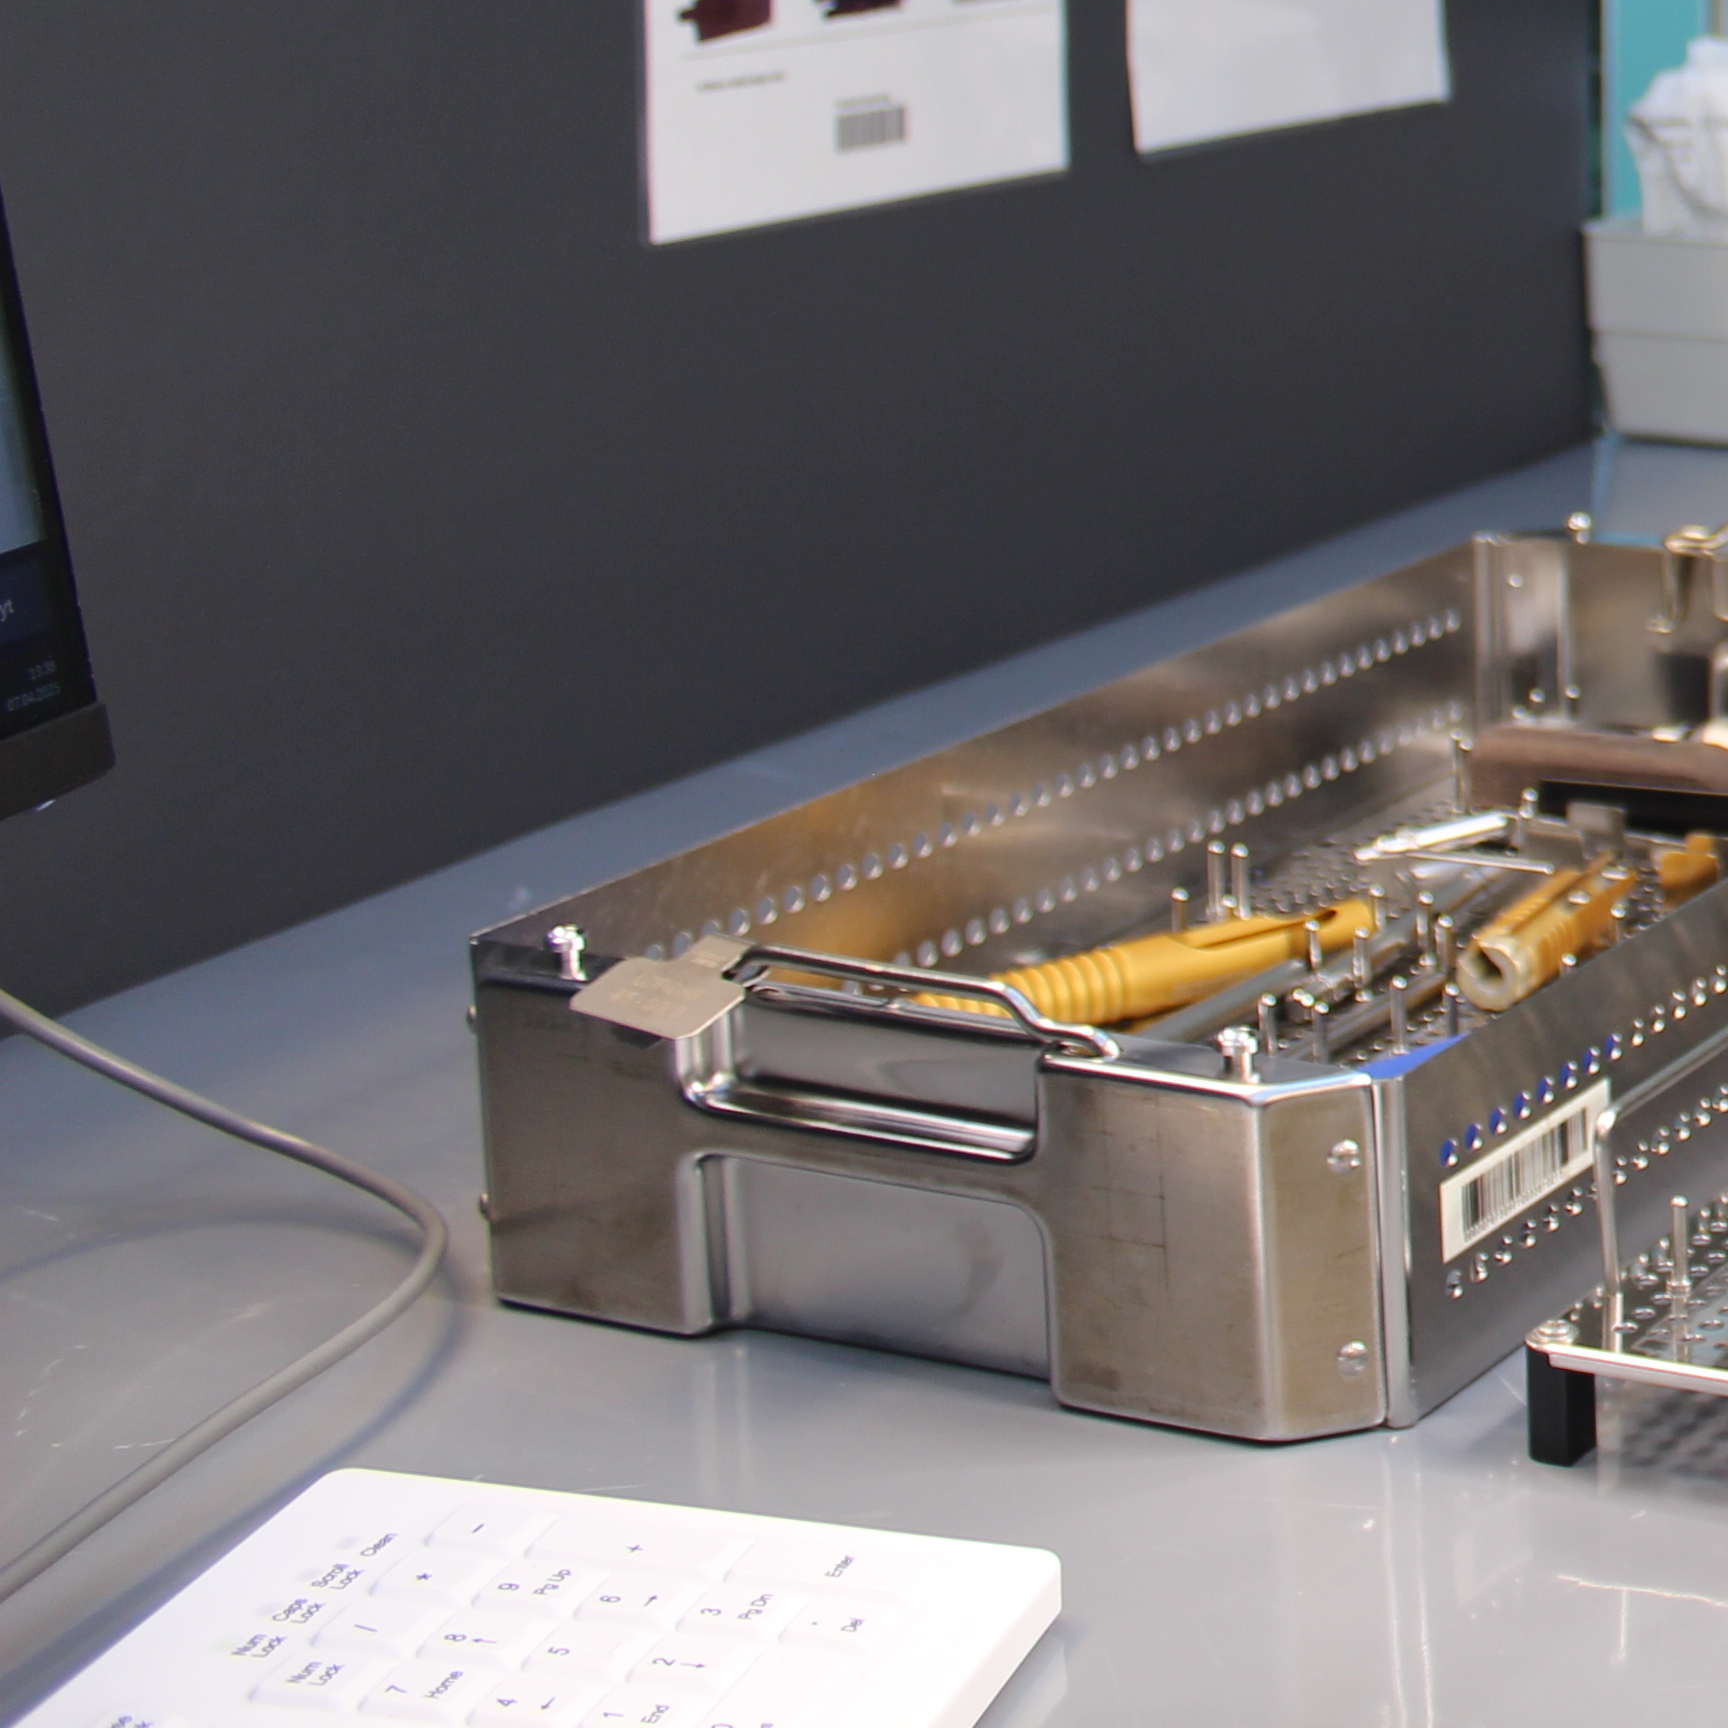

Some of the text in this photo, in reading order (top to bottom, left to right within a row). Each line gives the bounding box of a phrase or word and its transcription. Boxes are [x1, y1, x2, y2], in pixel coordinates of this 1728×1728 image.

[360, 1533, 397, 1556] Clean
[311, 1563, 349, 1588] Scroll
[826, 1555, 855, 1577] Enter
[329, 1569, 364, 1589] Lock
[272, 1598, 307, 1621] Caps
[290, 1603, 325, 1623] Lock
[841, 1618, 865, 1632] Del
[231, 1634, 267, 1656] Num
[251, 1636, 287, 1657] Lock
[547, 1646, 570, 1656] 5
[286, 1661, 322, 1683] Num
[652, 1657, 676, 1666] 2
[308, 1664, 345, 1685] Lock
[424, 1671, 463, 1698] Home
[384, 1685, 408, 1694] 7
[640, 1704, 670, 1723] End
